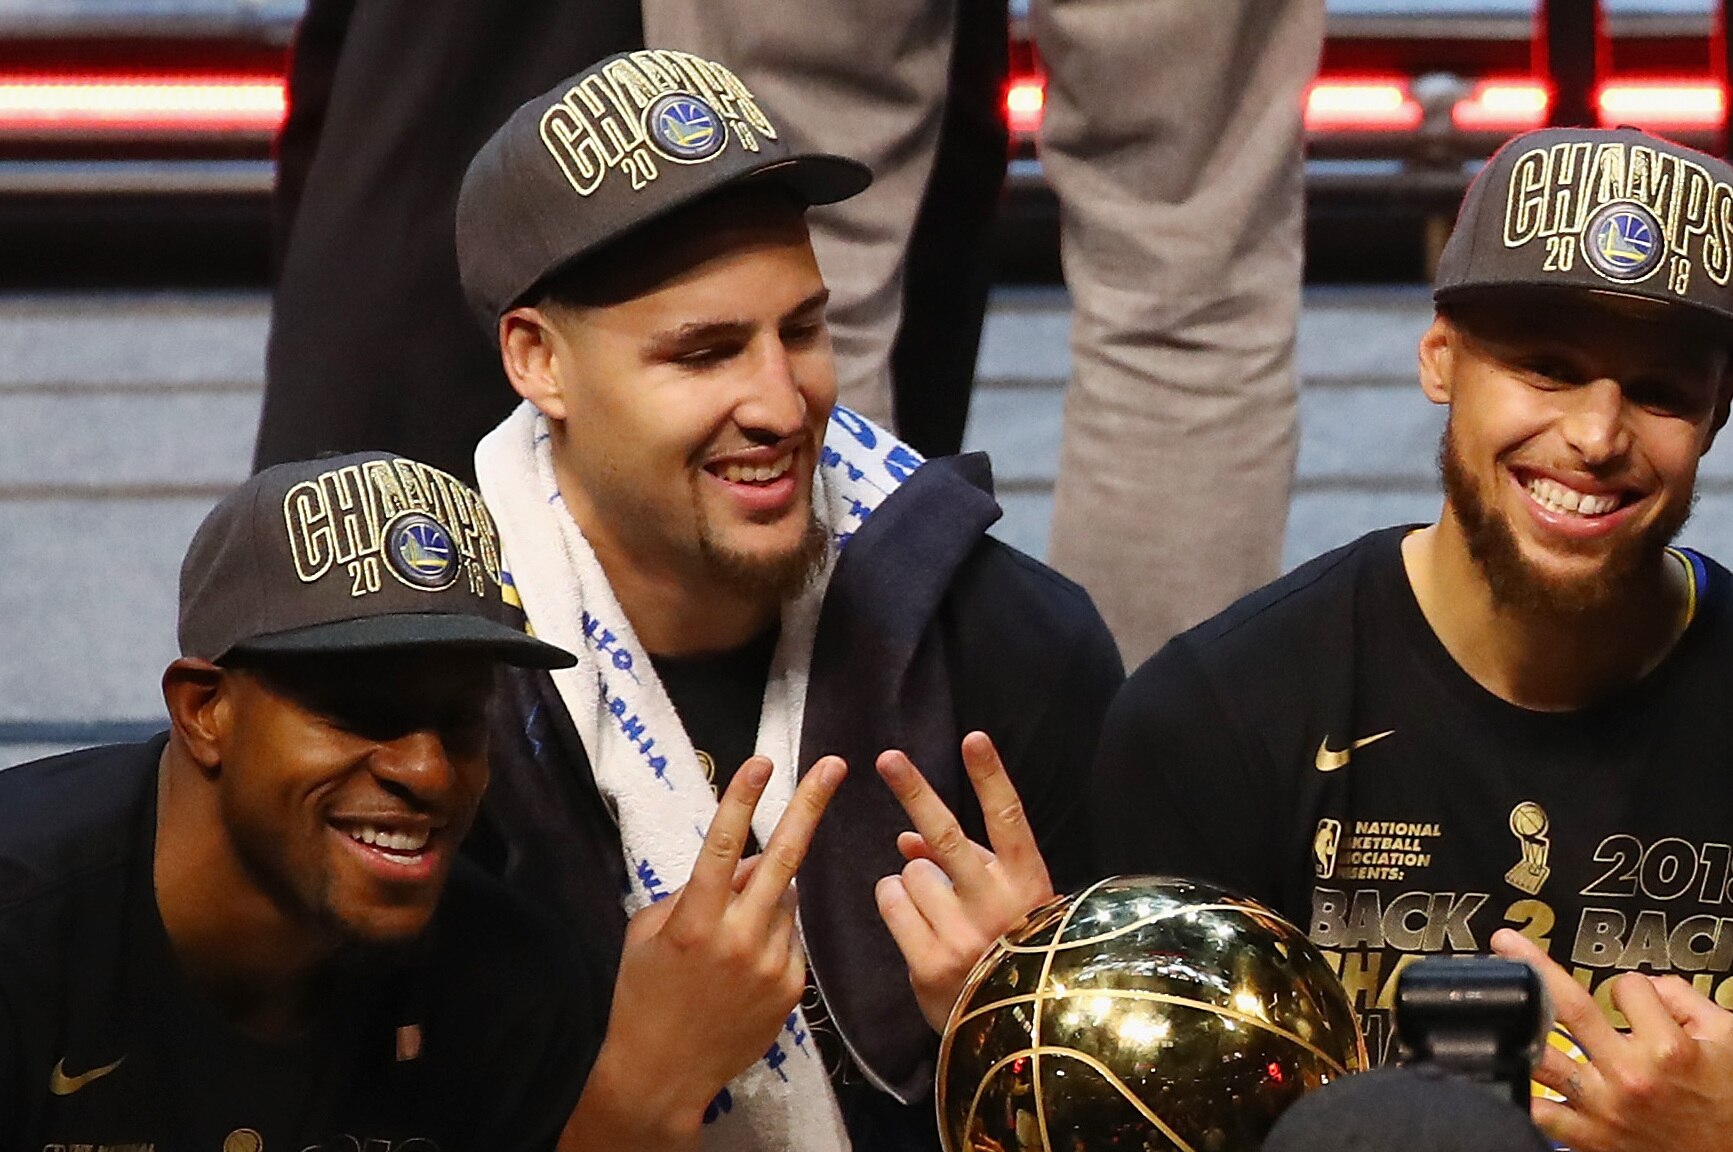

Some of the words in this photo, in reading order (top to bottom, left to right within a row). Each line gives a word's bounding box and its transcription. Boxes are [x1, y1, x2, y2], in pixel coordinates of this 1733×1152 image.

[539, 49, 777, 196] CHAMPS
[623, 154, 658, 191] 20
[1543, 236, 1575, 272] 20
[1669, 256, 1692, 295] 18
[284, 458, 502, 582] CHAMPS
[348, 556, 380, 598] 20
[1355, 821, 1442, 837] NATIONAL
[1309, 885, 1490, 951] BACK
